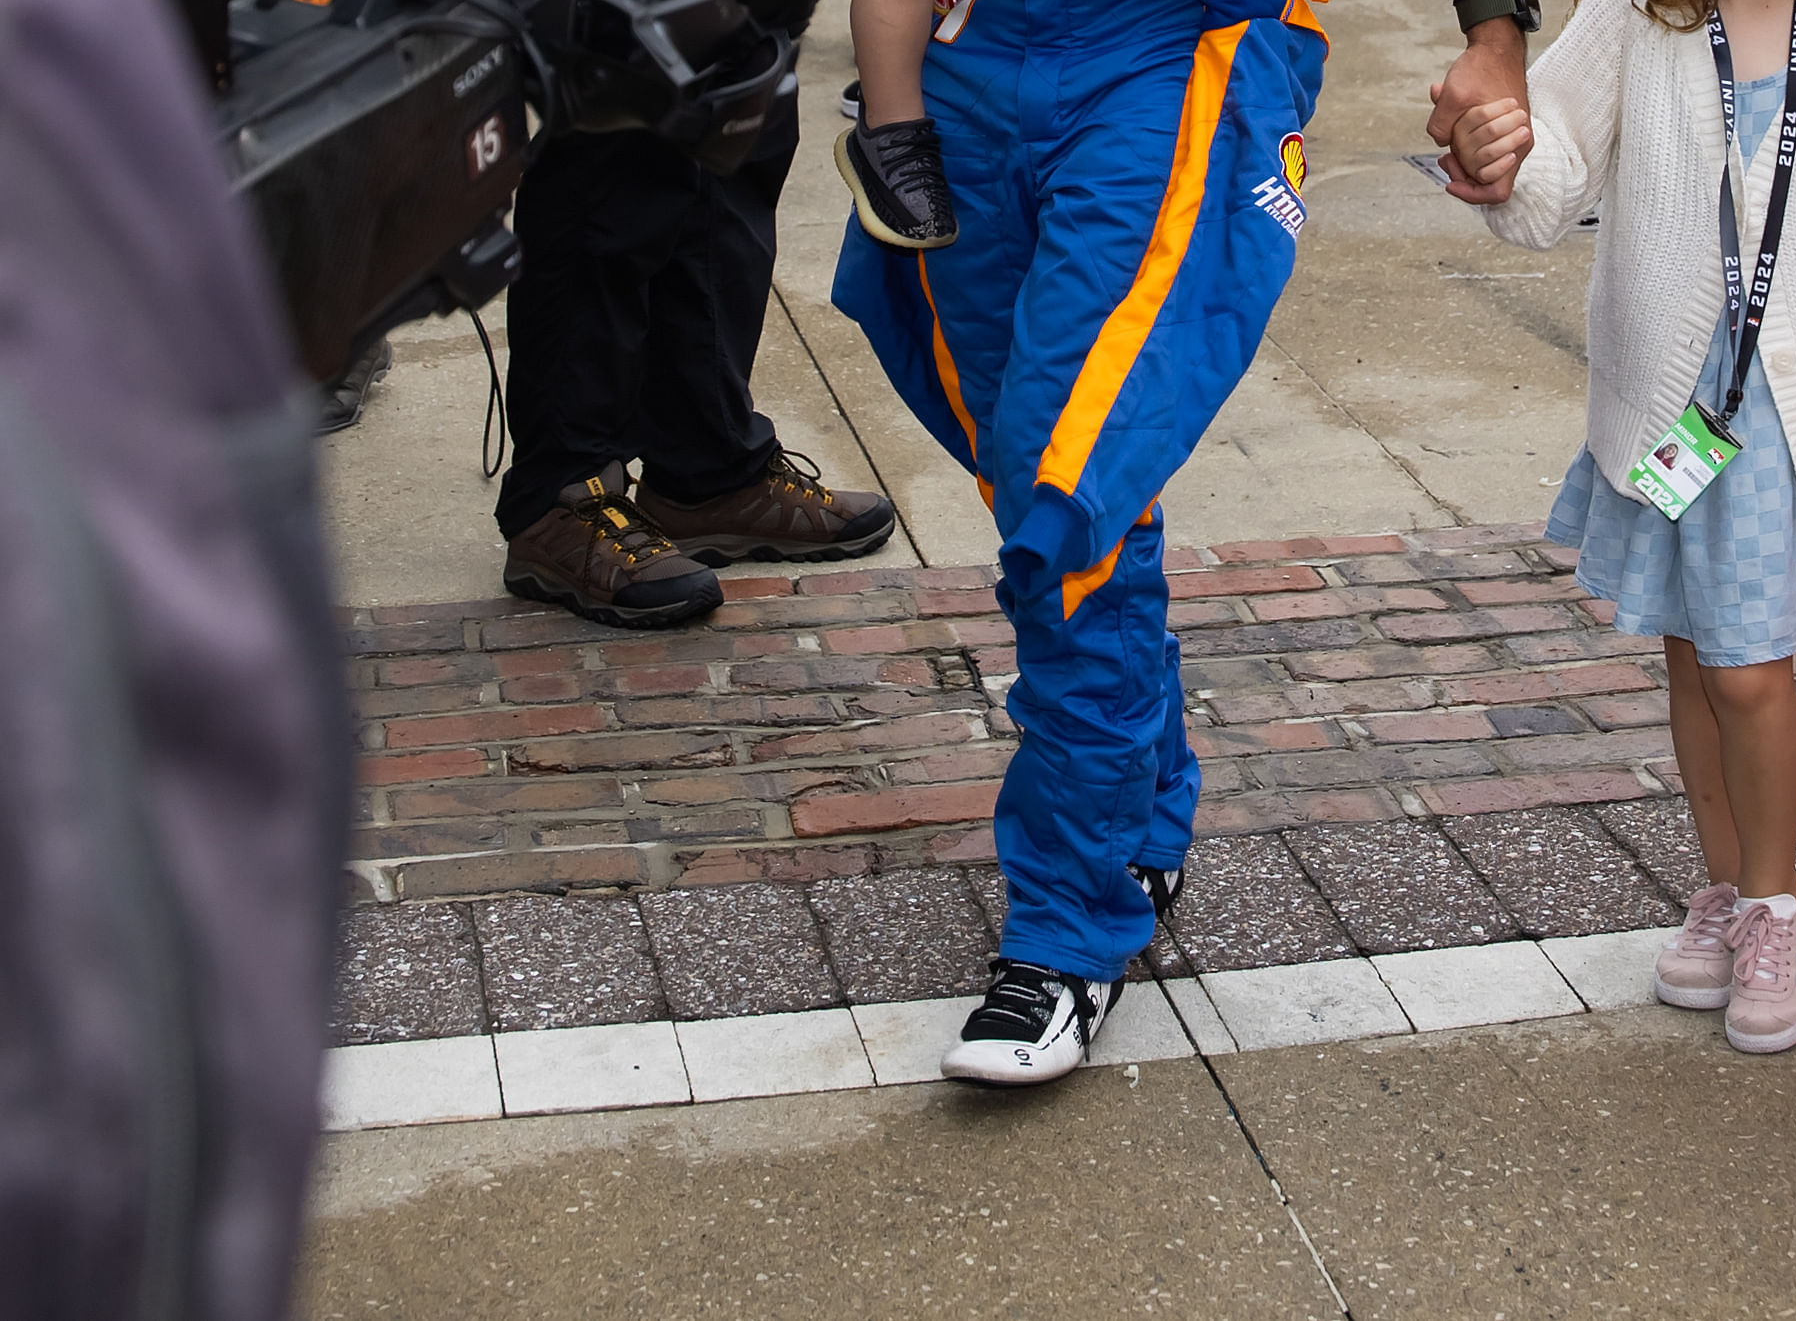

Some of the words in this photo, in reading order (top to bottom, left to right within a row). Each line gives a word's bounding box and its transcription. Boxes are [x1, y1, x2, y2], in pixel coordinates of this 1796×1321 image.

[453, 45, 504, 98] SONY
[471, 118, 502, 174] 15
[1724, 255, 1740, 313] 2024
[1750, 252, 1775, 309] 2024
[1634, 471, 1684, 521] 2024
